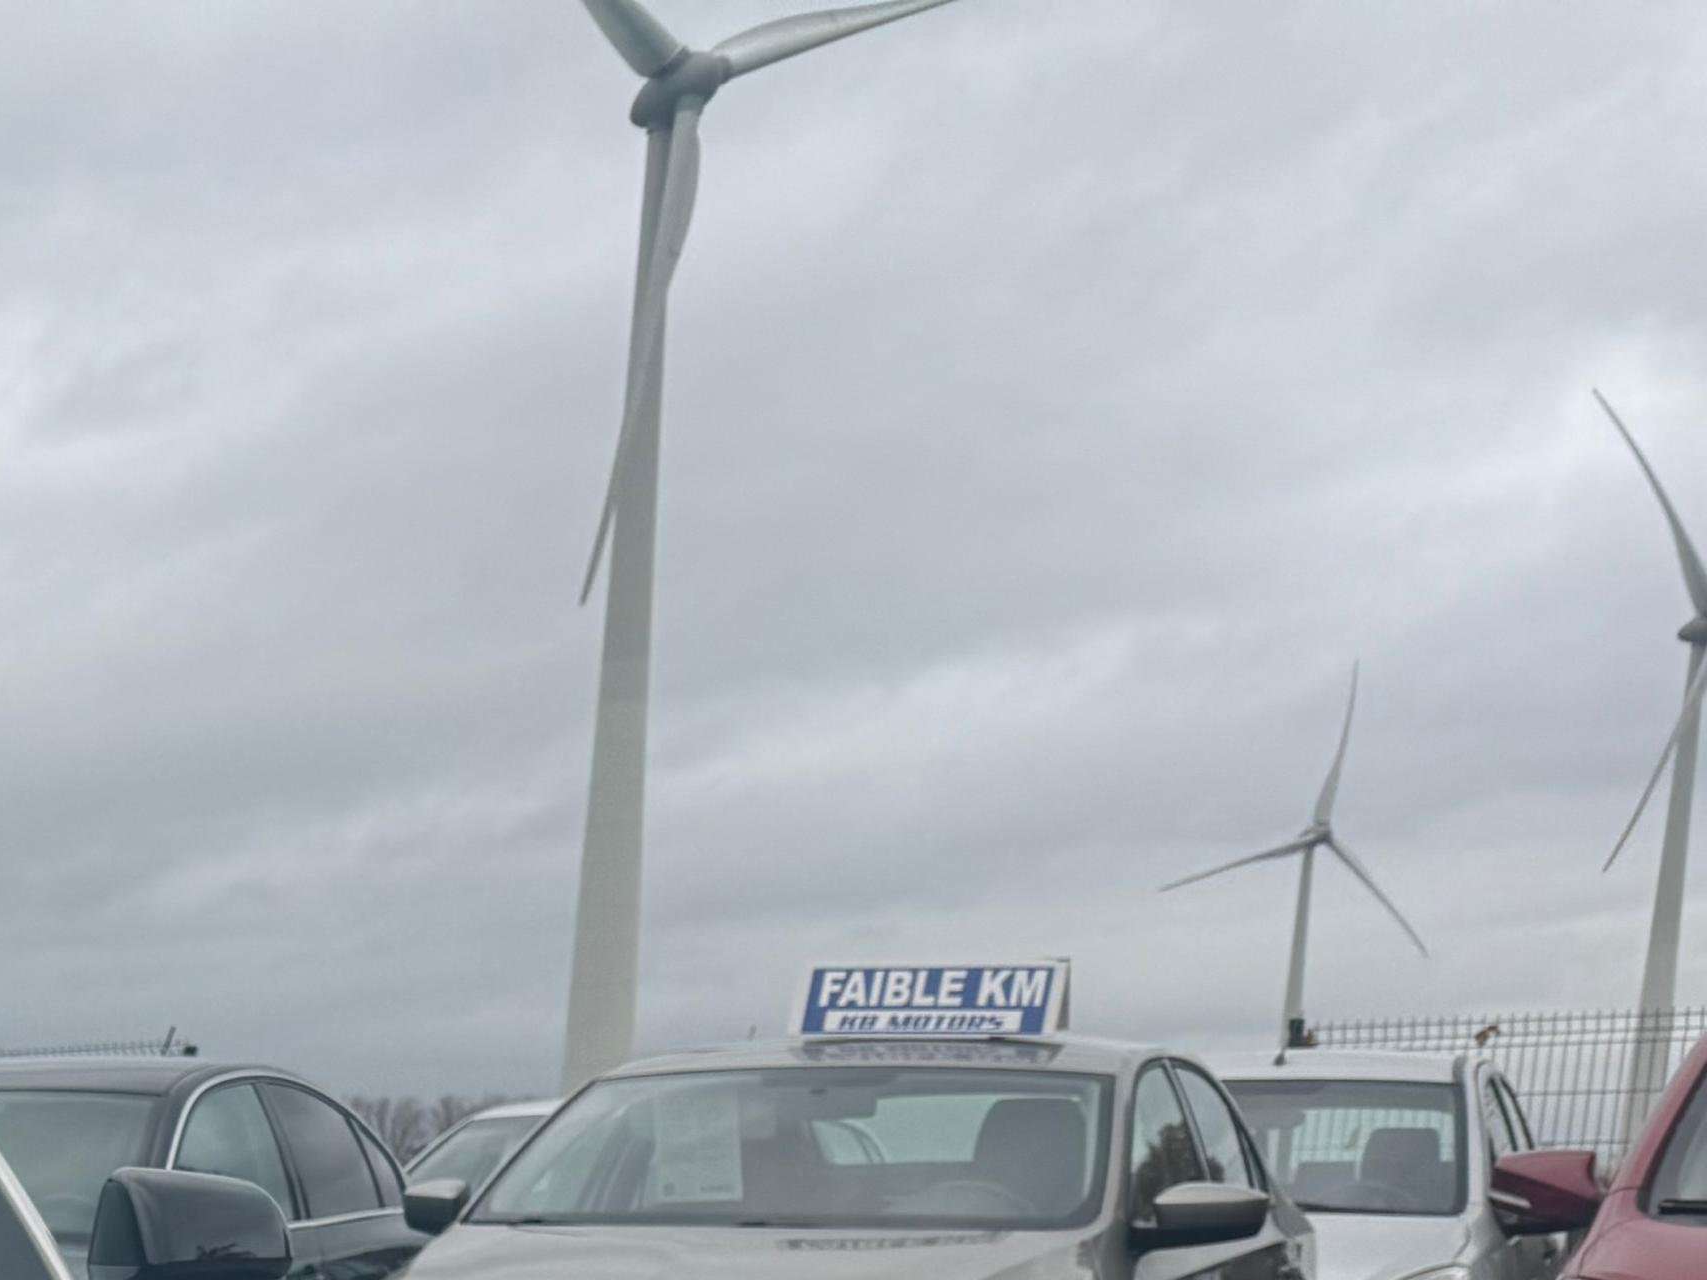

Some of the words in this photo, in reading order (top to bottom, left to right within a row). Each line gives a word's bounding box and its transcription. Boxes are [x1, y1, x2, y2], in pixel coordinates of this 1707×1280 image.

[818, 970, 969, 1007] FAIBLE
[977, 969, 1048, 1007] KM
[887, 1014, 1005, 1031] MOTORS
